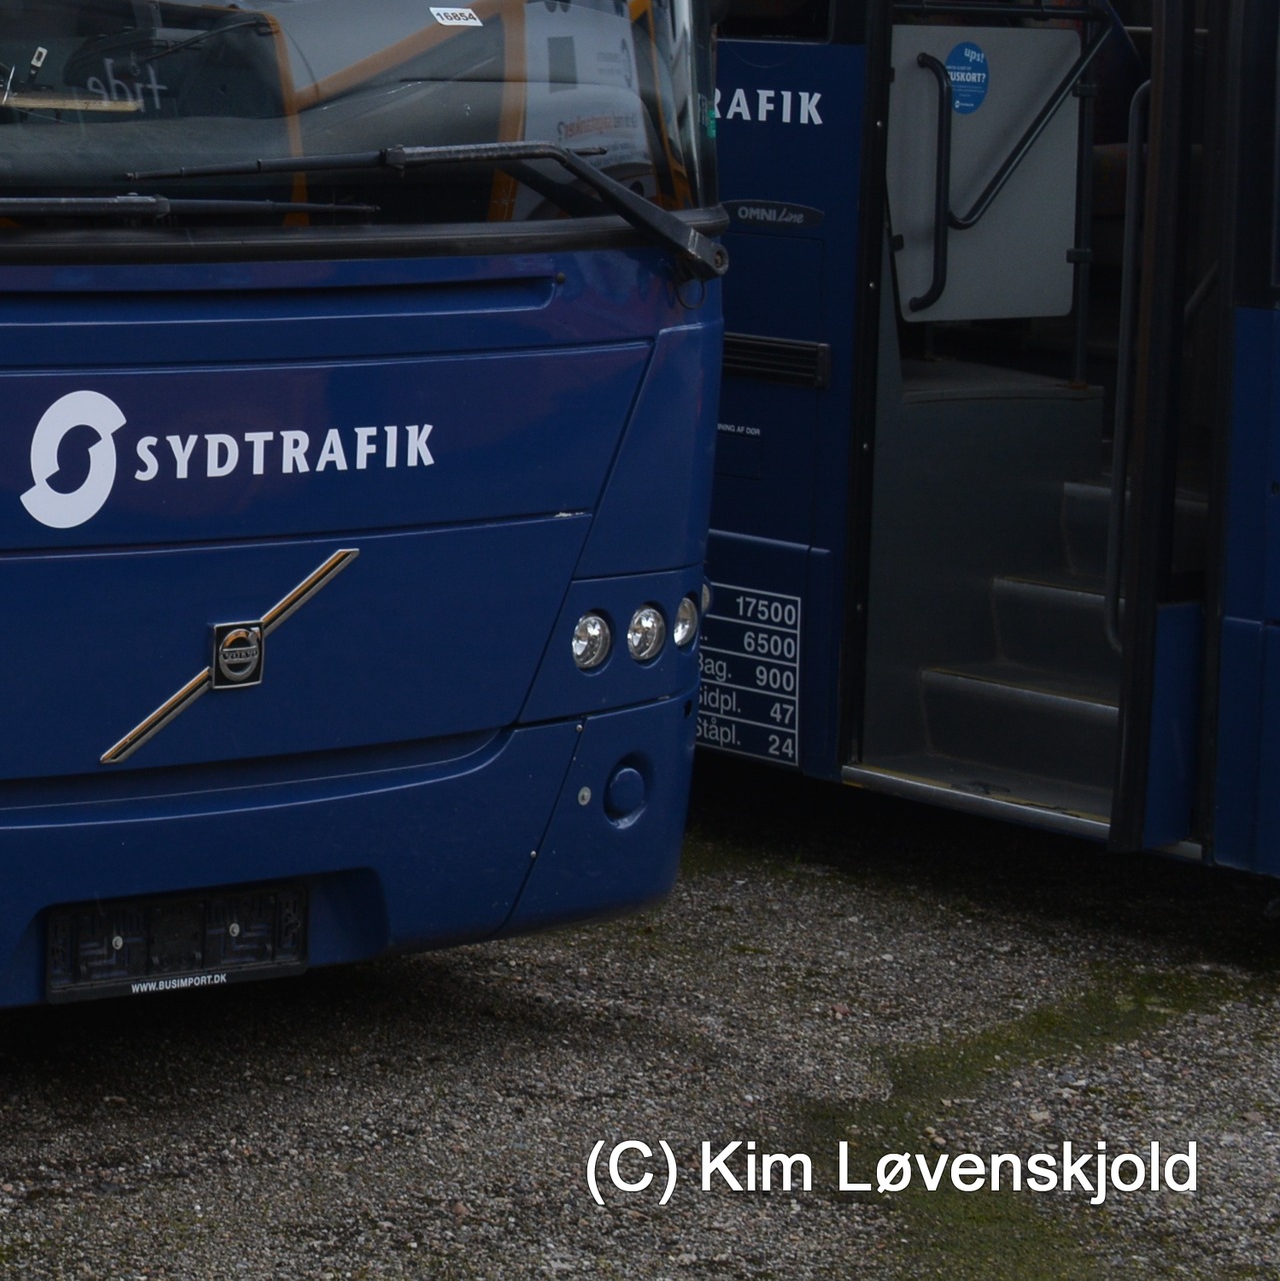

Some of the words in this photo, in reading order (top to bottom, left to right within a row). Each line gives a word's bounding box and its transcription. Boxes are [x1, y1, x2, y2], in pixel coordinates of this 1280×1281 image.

[436, 12, 477, 21] 16854
[964, 48, 985, 63] ups!
[135, 423, 436, 482] SYDTRAFIK
[735, 595, 797, 626] 17500
[222, 649, 258, 660] VOLVO
[743, 631, 796, 659] 6500
[755, 665, 795, 692] 900
[769, 702, 795, 725] 47
[768, 734, 794, 758] 24
[131, 972, 228, 994] WWW.BUSIMPORT.DK
